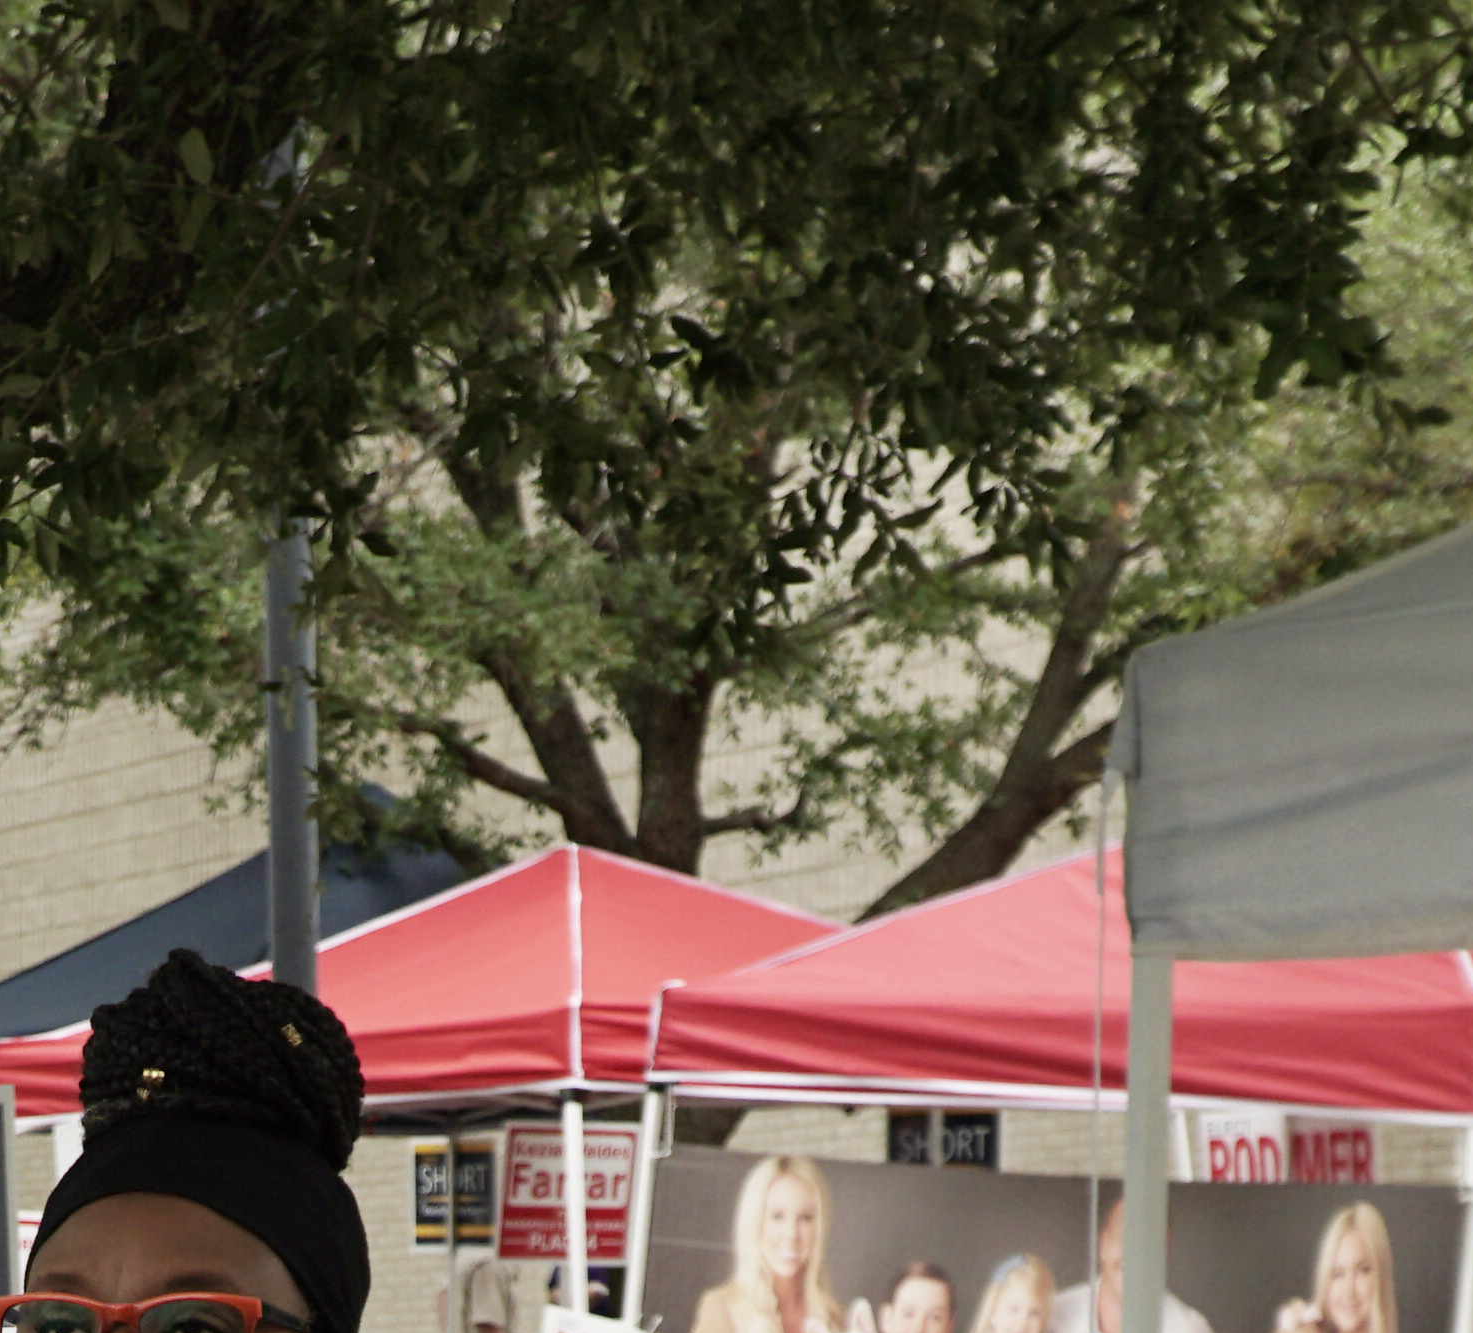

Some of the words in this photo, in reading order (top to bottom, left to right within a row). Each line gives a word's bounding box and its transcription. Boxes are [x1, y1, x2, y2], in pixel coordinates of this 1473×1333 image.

[1208, 1128, 1374, 1184] RODMER
[419, 1164, 486, 1195] SHRT
[511, 1162, 627, 1200] Farar
